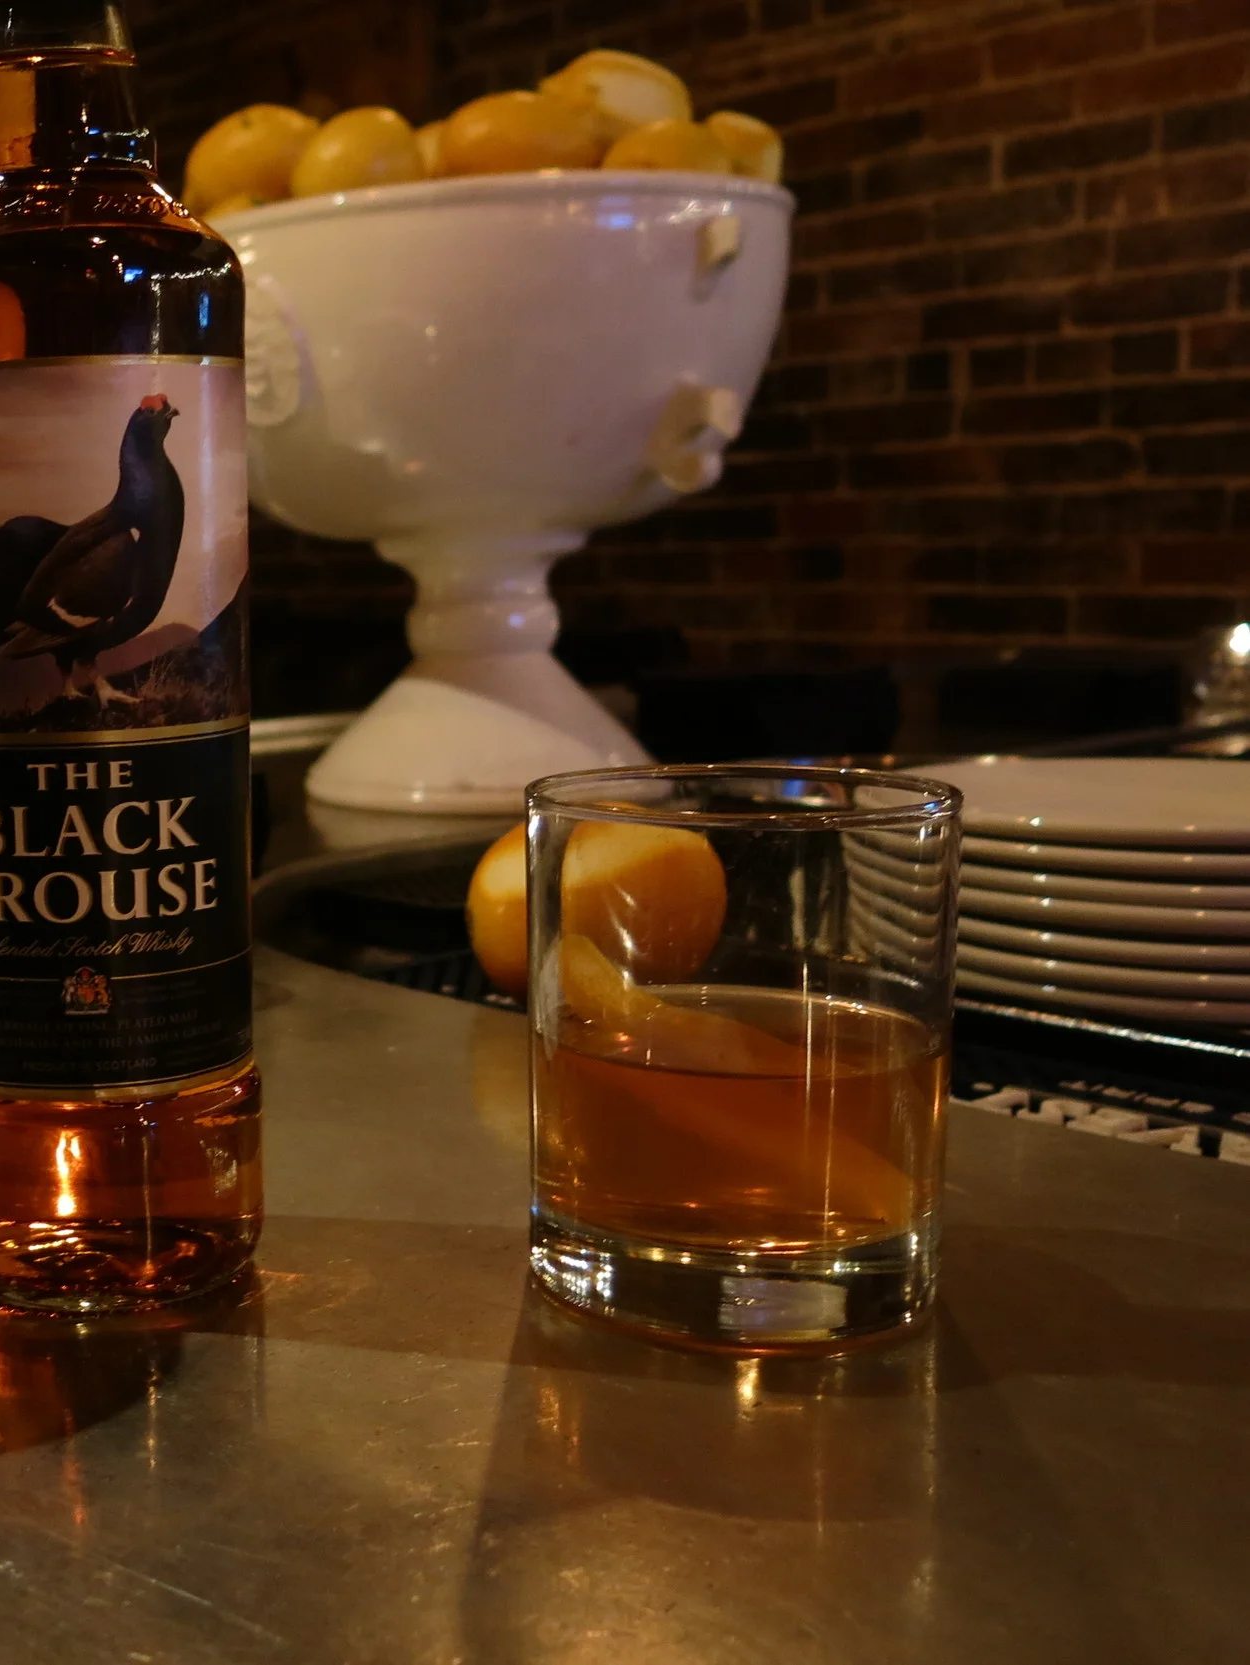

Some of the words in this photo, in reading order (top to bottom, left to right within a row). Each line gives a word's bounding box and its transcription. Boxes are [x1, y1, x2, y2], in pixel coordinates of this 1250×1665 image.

[27, 759, 134, 792] THE
[57, 932, 123, 958] Scotch
[126, 927, 195, 956] Whisky
